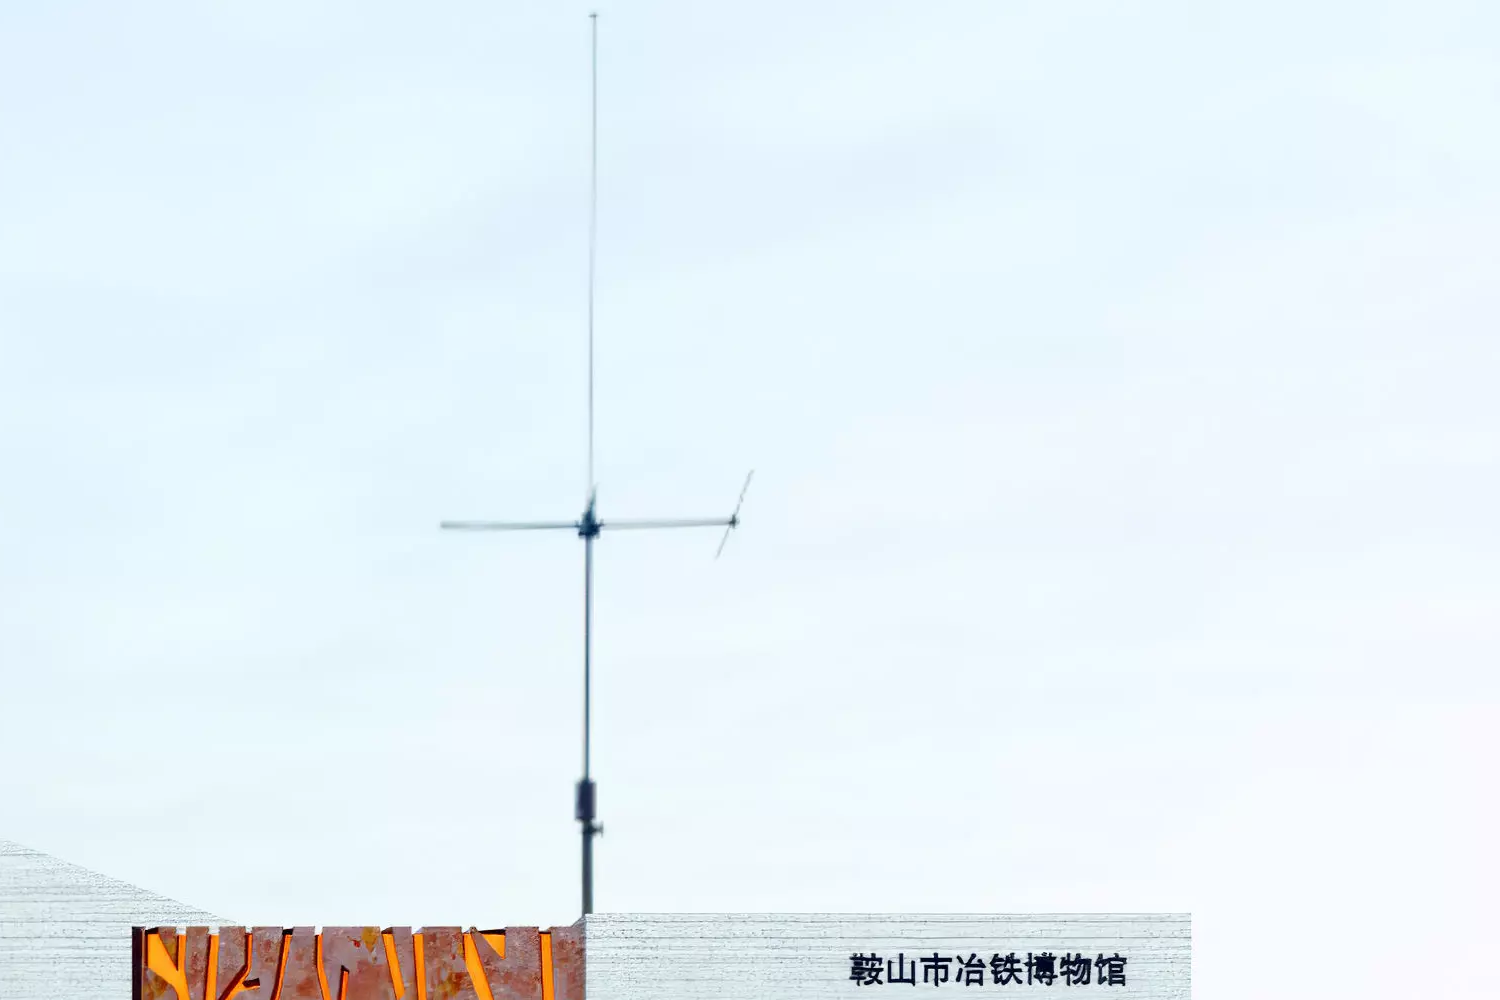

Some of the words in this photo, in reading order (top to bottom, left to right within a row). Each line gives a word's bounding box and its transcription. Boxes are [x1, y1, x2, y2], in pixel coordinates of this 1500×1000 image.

[848, 951, 1128, 987] 鞍山市冶铁博物馆
